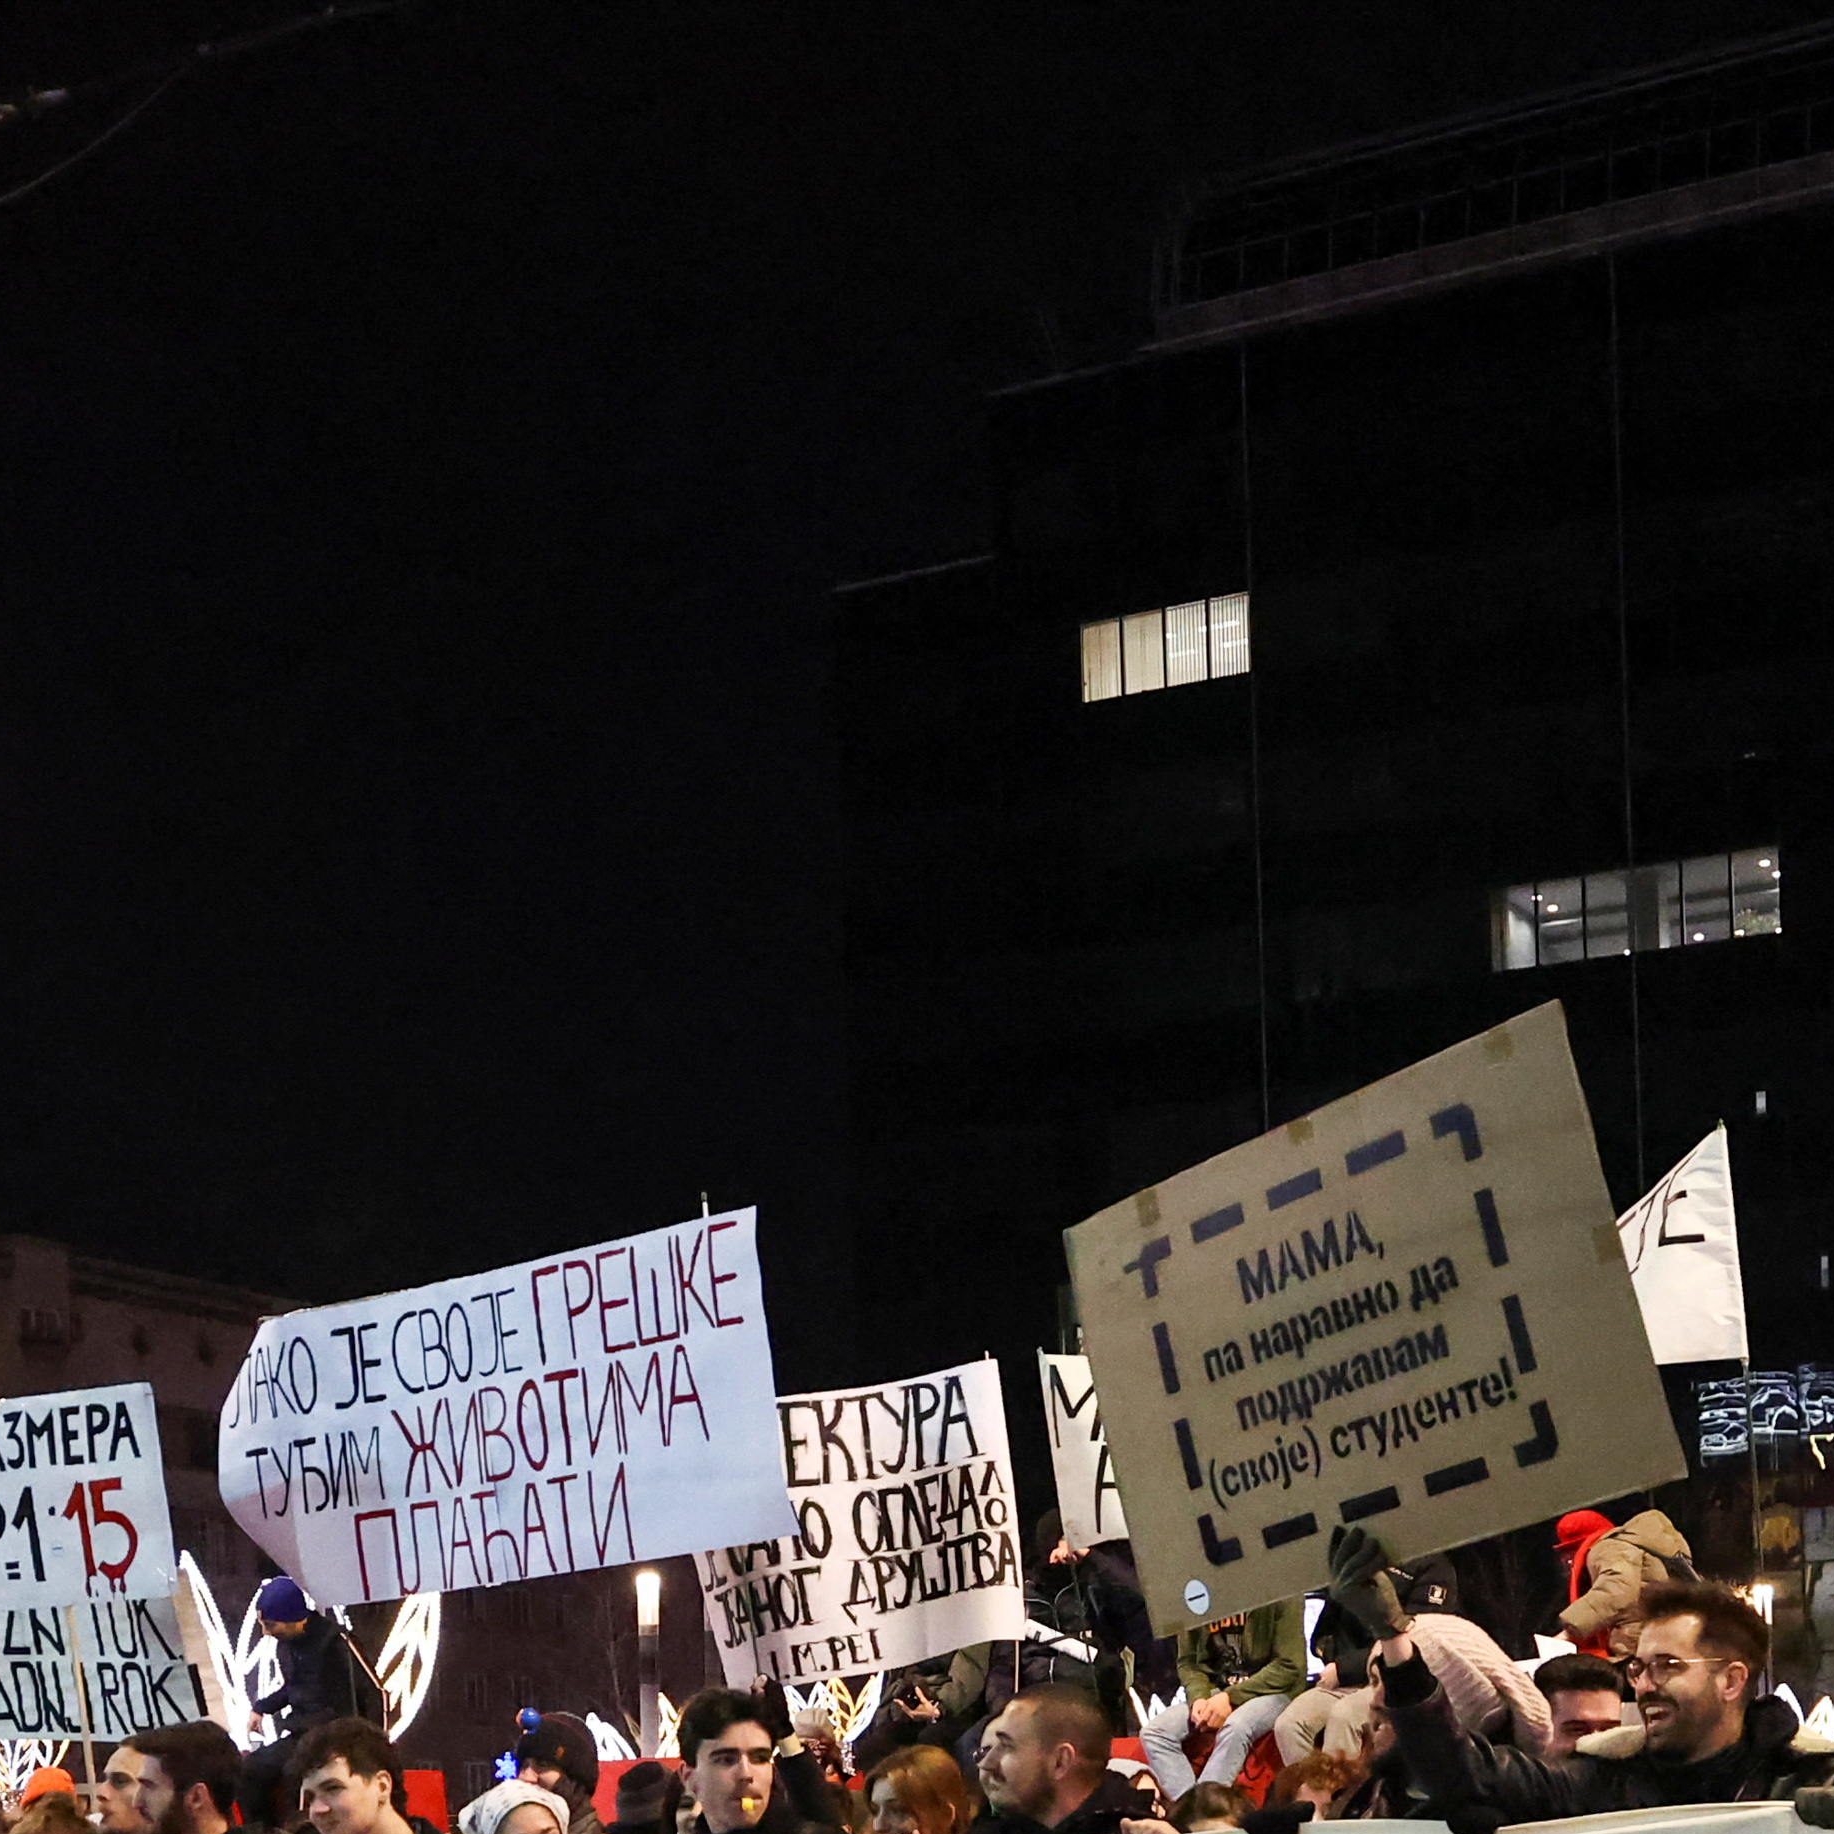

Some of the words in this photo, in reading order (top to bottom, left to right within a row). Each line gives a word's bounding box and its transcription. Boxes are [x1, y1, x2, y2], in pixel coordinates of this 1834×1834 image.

[330, 1323, 387, 1410] ЈЕ
[391, 1288, 523, 1394] СВОЈЕ
[530, 1221, 744, 1366] ГРЕШКЕ
[1204, 1342, 1244, 1383] па
[1249, 1280, 1400, 1364] наравно
[1409, 1256, 1459, 1312] да
[1236, 1211, 1384, 1304] МАМА,
[245, 1426, 385, 1519] ТУЂИМ
[390, 1344, 710, 1498] ЖИВОТИМА
[1209, 1426, 1321, 1511] (своје)
[1330, 1356, 1517, 1458] студенте!
[1236, 1324, 1450, 1431] подржавам
[354, 1463, 636, 1600] ПЛАЋАТИ
[841, 1529, 1021, 1626] ДРУШТВА
